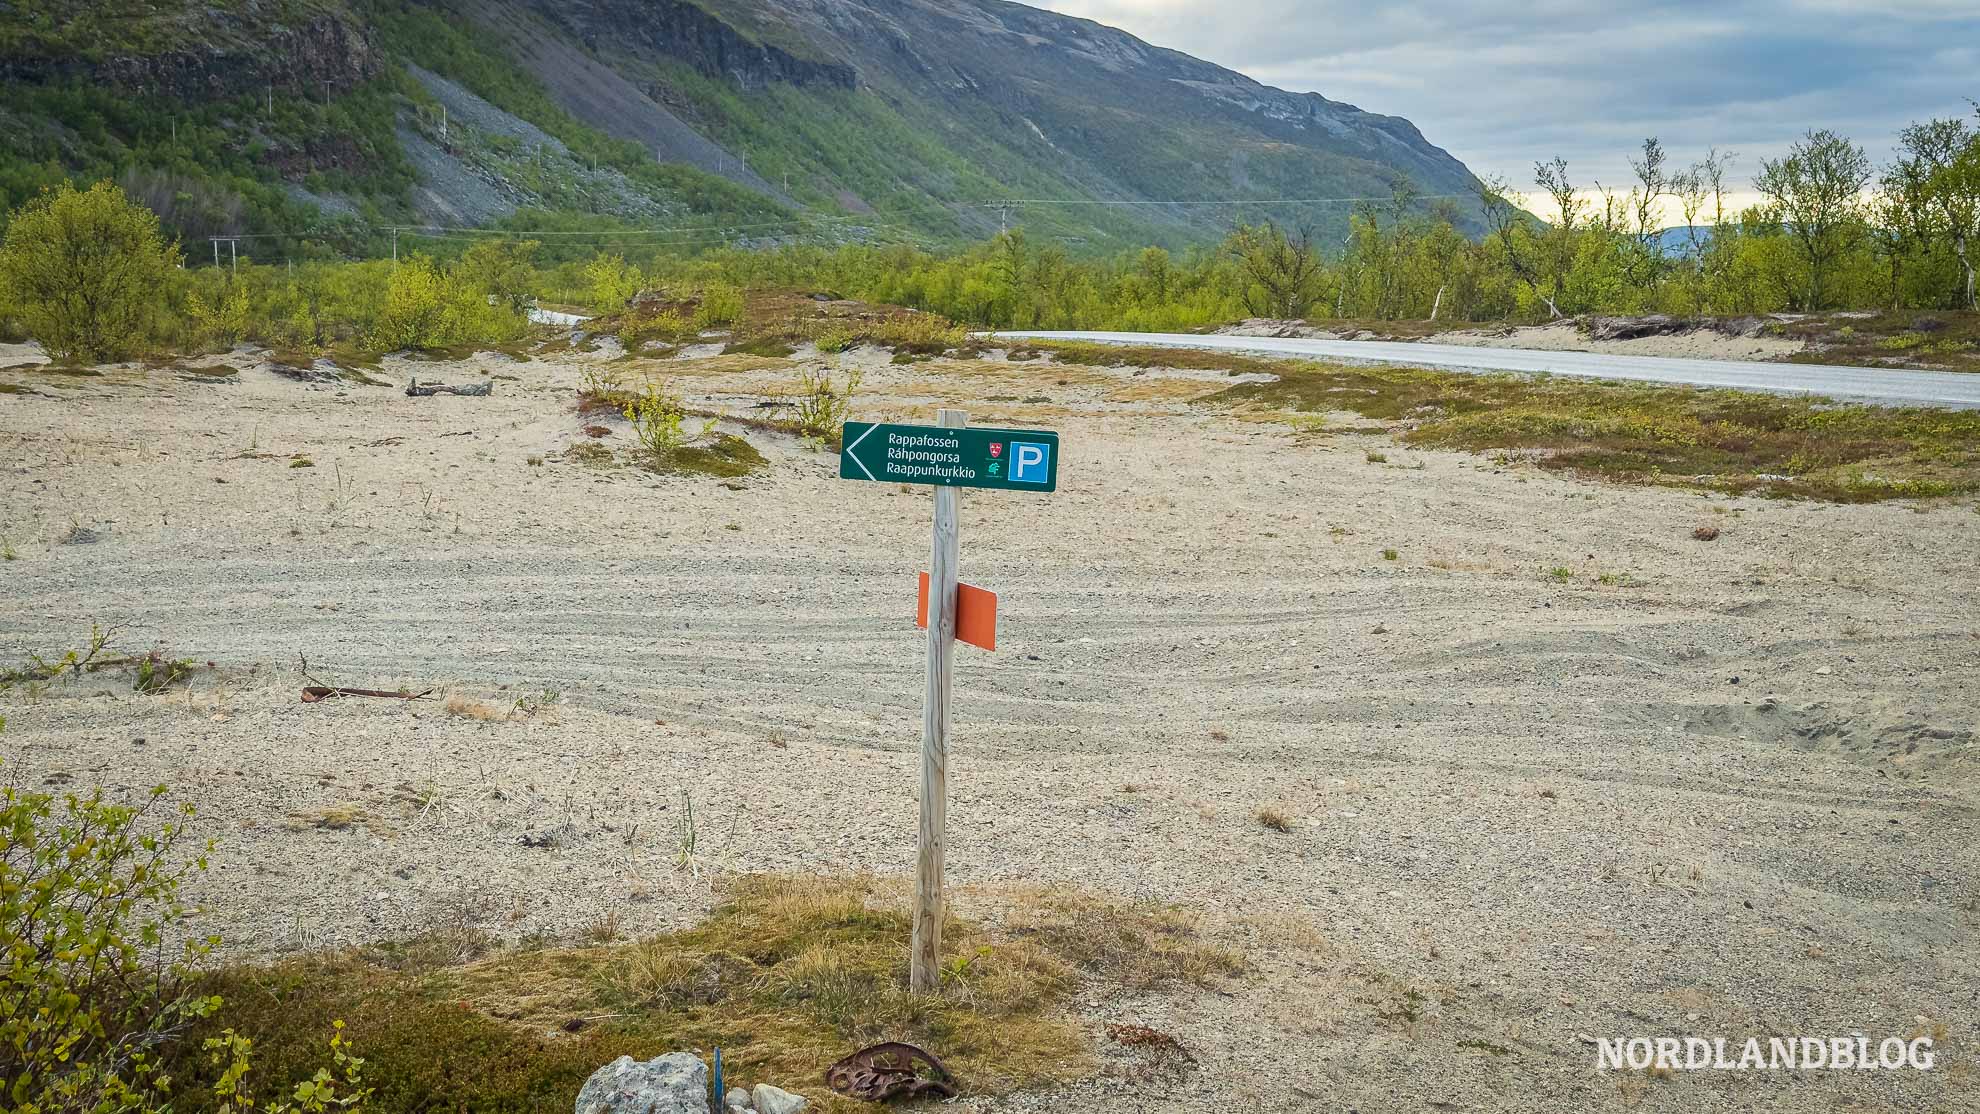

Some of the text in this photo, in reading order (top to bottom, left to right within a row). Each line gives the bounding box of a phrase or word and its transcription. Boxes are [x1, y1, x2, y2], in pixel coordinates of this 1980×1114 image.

[889, 433, 959, 448] Rappafossen
[888, 448, 960, 463] Ráhpongorsa
[1018, 446, 1043, 478] P
[886, 462, 976, 479] Raappunkurkkio
